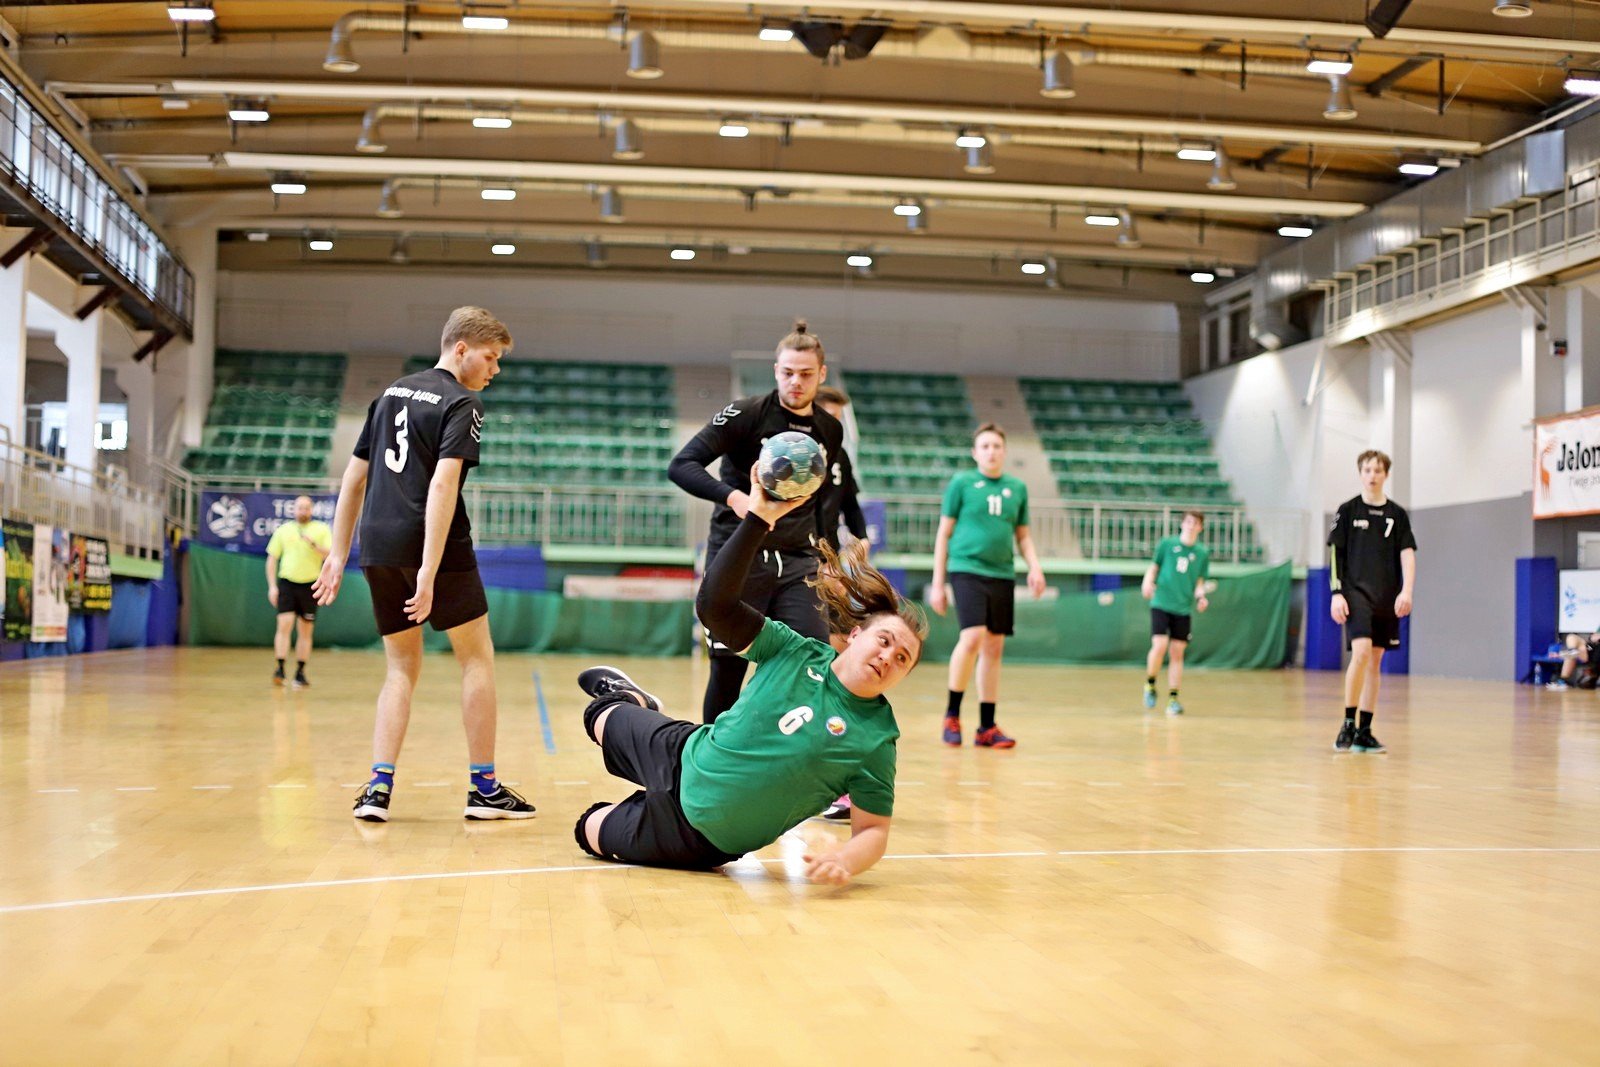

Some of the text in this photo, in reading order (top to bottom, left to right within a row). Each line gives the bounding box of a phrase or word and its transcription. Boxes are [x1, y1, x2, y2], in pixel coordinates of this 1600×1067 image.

[384, 405, 409, 474] 3
[986, 493, 1003, 517] 11
[1384, 517, 1395, 538] 7
[778, 705, 814, 736] 6
